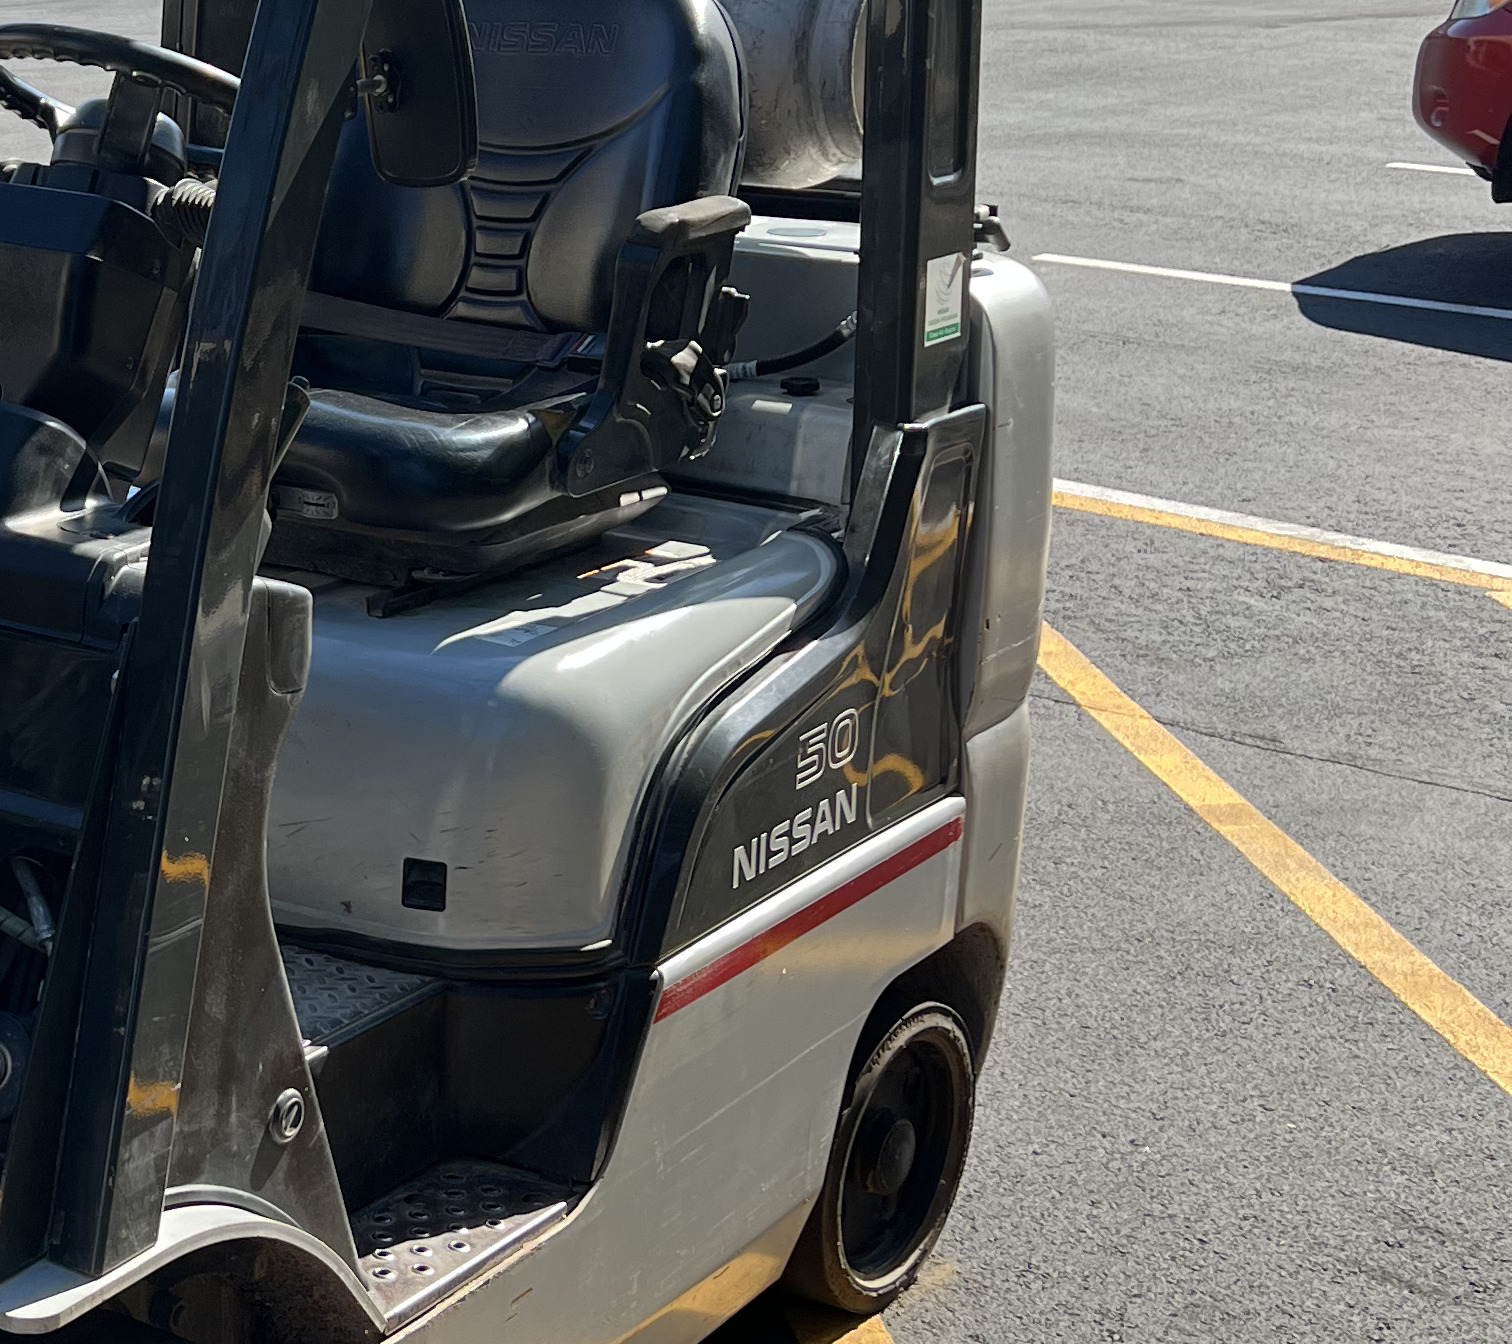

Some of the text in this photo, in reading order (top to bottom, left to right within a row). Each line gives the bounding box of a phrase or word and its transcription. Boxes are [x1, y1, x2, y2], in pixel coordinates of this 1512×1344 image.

[467, 21, 619, 56] NISSAN
[796, 708, 859, 791] 50
[732, 782, 858, 889] NISSAN
